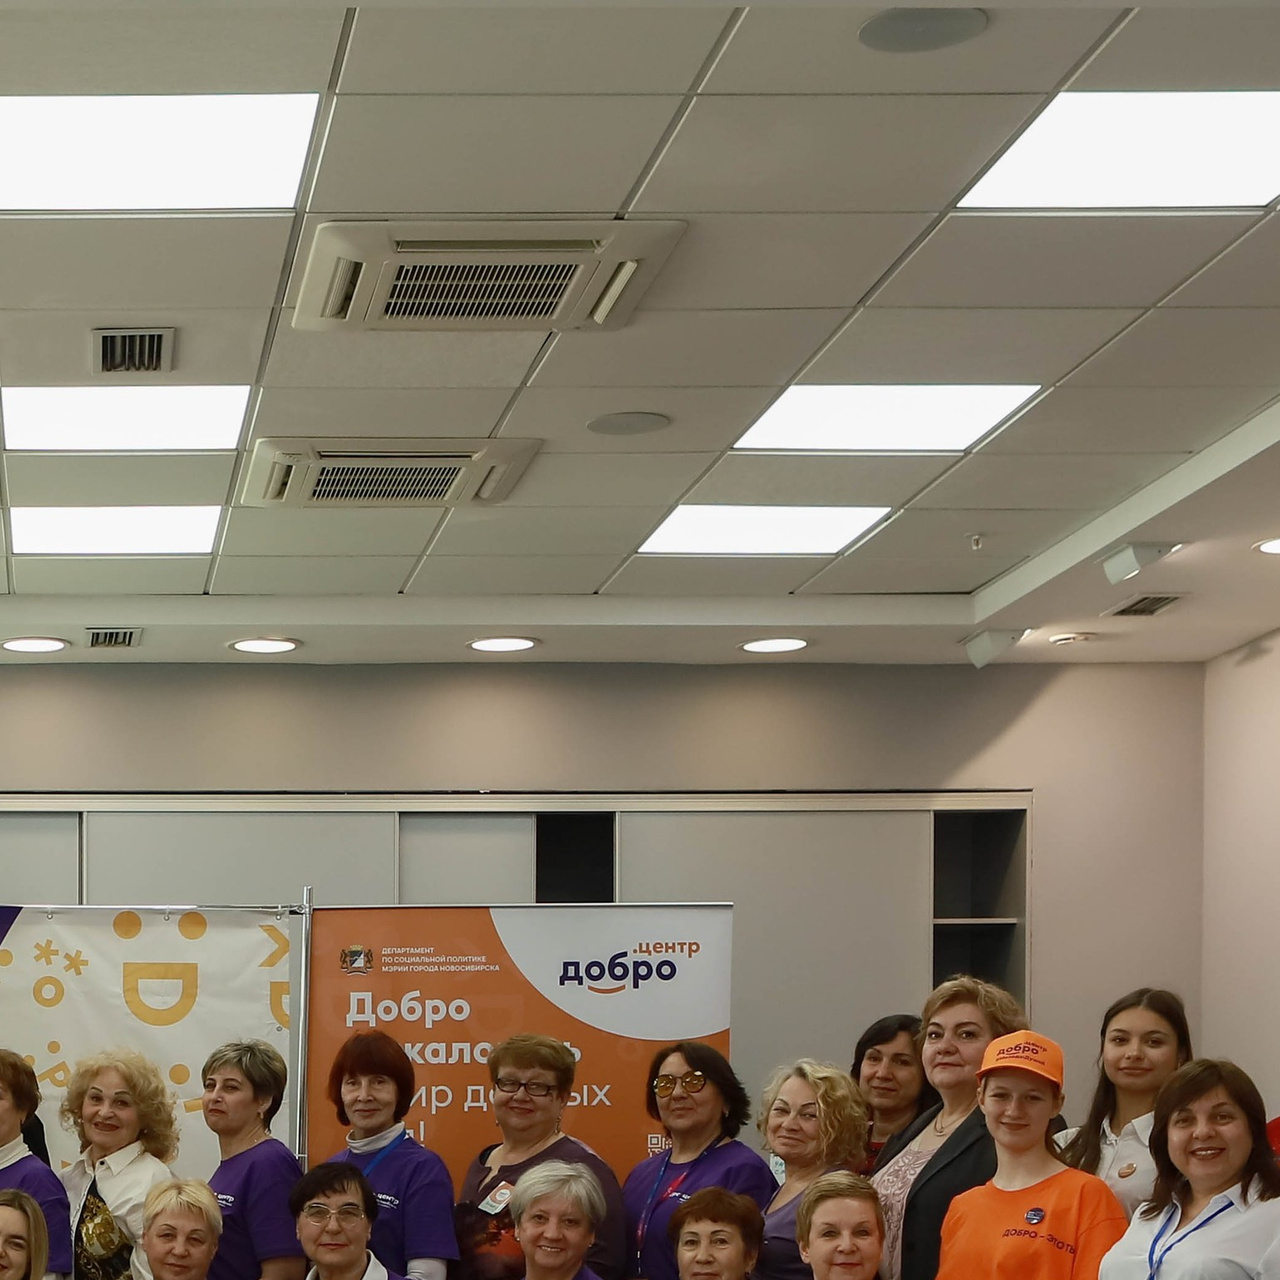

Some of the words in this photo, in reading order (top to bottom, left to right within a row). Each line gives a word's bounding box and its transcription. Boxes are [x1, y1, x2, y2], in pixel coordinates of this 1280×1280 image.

[633, 941, 701, 959] .центр
[394, 955, 446, 963] СОЦИАЛЬНОЙ
[559, 951, 677, 990] добро
[346, 990, 471, 1029] Добро
[996, 1043, 1039, 1056] добро
[1002, 1229, 1038, 1238] ДОБРО
